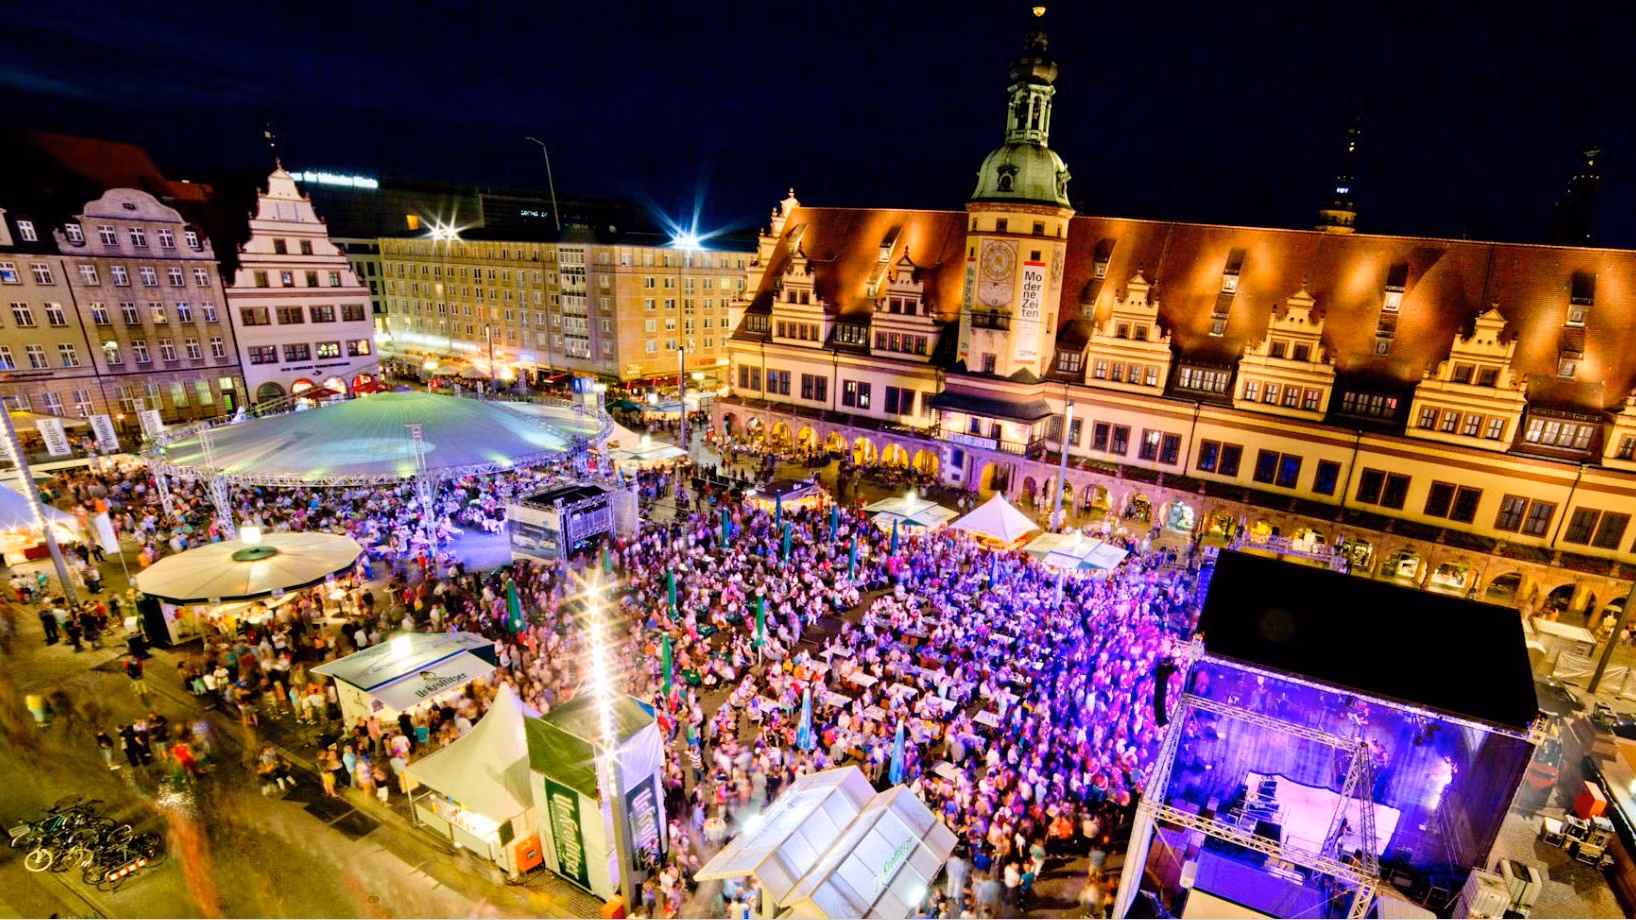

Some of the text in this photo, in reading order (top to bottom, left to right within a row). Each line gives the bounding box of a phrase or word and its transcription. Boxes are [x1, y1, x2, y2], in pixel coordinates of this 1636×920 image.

[1024, 271, 1042, 282] Mo
[1023, 282, 1042, 291] der
[1023, 290, 1037, 299] ne
[1022, 299, 1039, 309] Zei
[1021, 309, 1039, 318] ten
